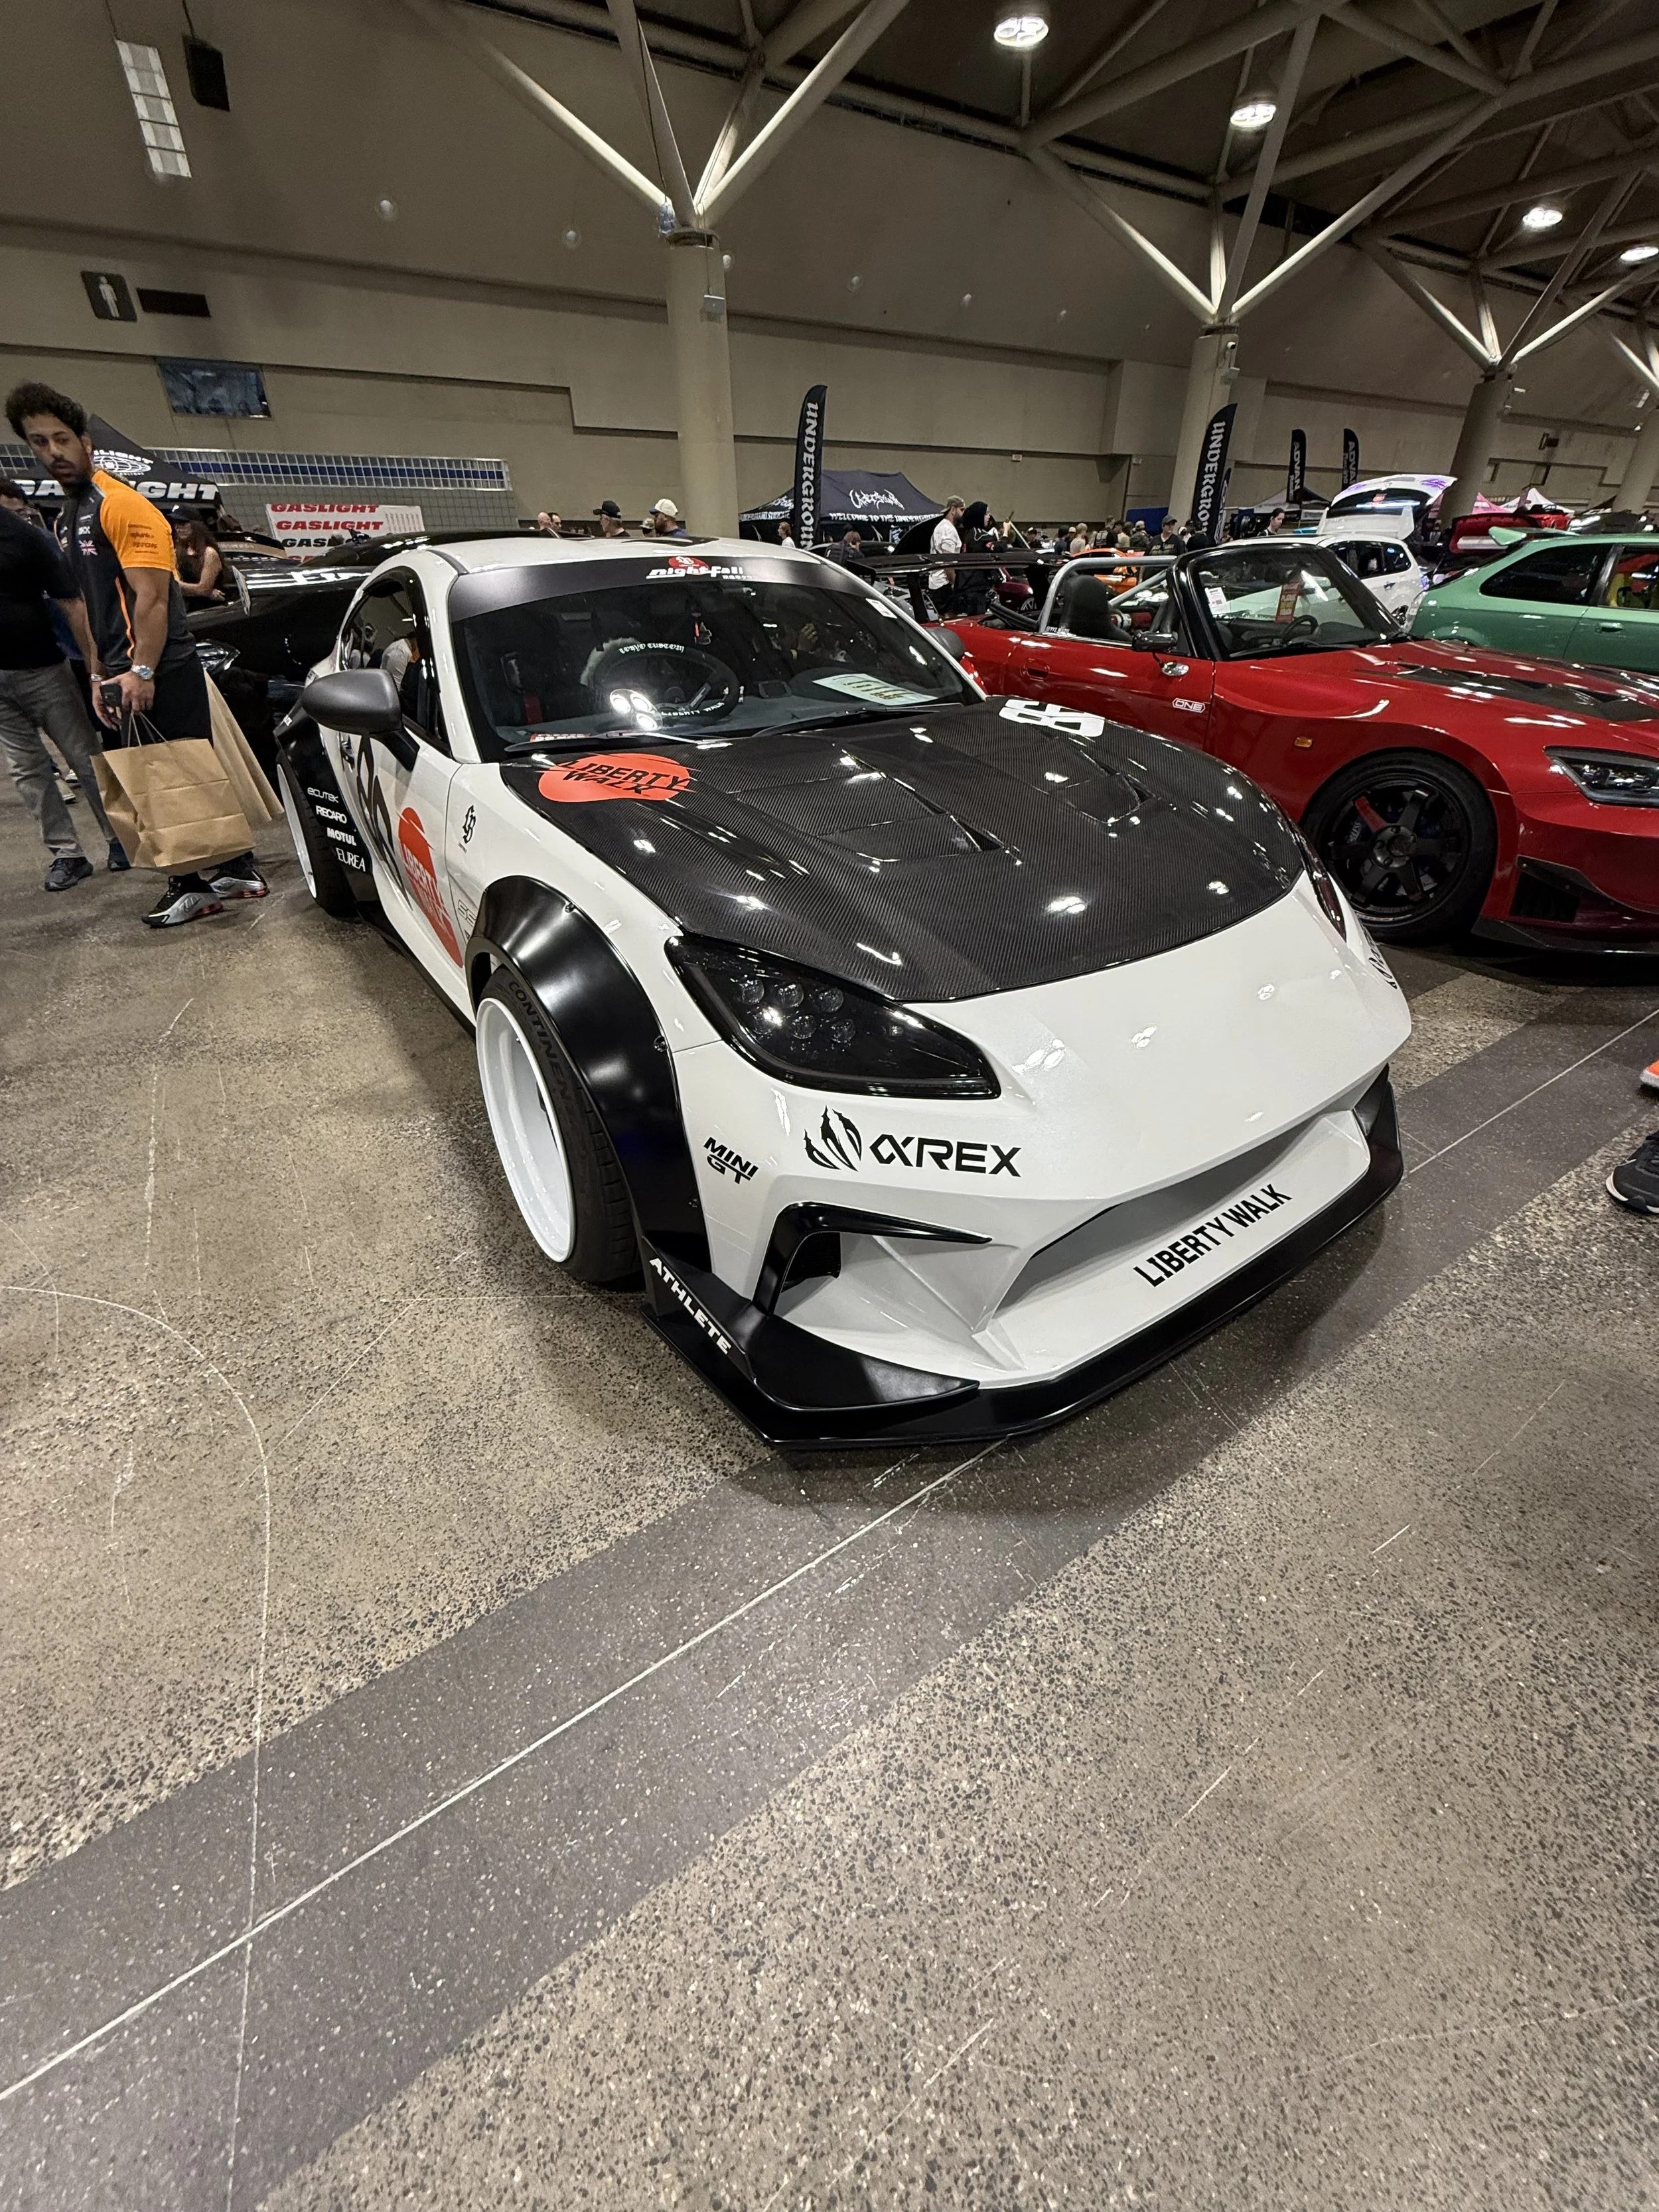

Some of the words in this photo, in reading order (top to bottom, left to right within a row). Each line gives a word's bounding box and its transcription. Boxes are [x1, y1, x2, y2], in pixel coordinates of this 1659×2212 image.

[799, 402, 819, 550] UNDERGROUN
[1196, 421, 1226, 531] UNDERGRO
[270, 504, 380, 513] GASLIGHT
[829, 513, 869, 522] WELCOME
[275, 520, 384, 530] GASLIGHT
[556, 760, 691, 790] LIBERTY
[563, 771, 652, 795] WALK
[315, 805, 347, 824] RECARO
[326, 827, 356, 846] MOTUL
[335, 848, 366, 872] EUREA
[703, 1136, 758, 1177] MINI
[707, 1153, 751, 1185] GT
[1133, 1217, 1235, 1288] LIBERTY
[1220, 1183, 1293, 1228] WALK
[649, 1258, 732, 1355] ATHLETE
